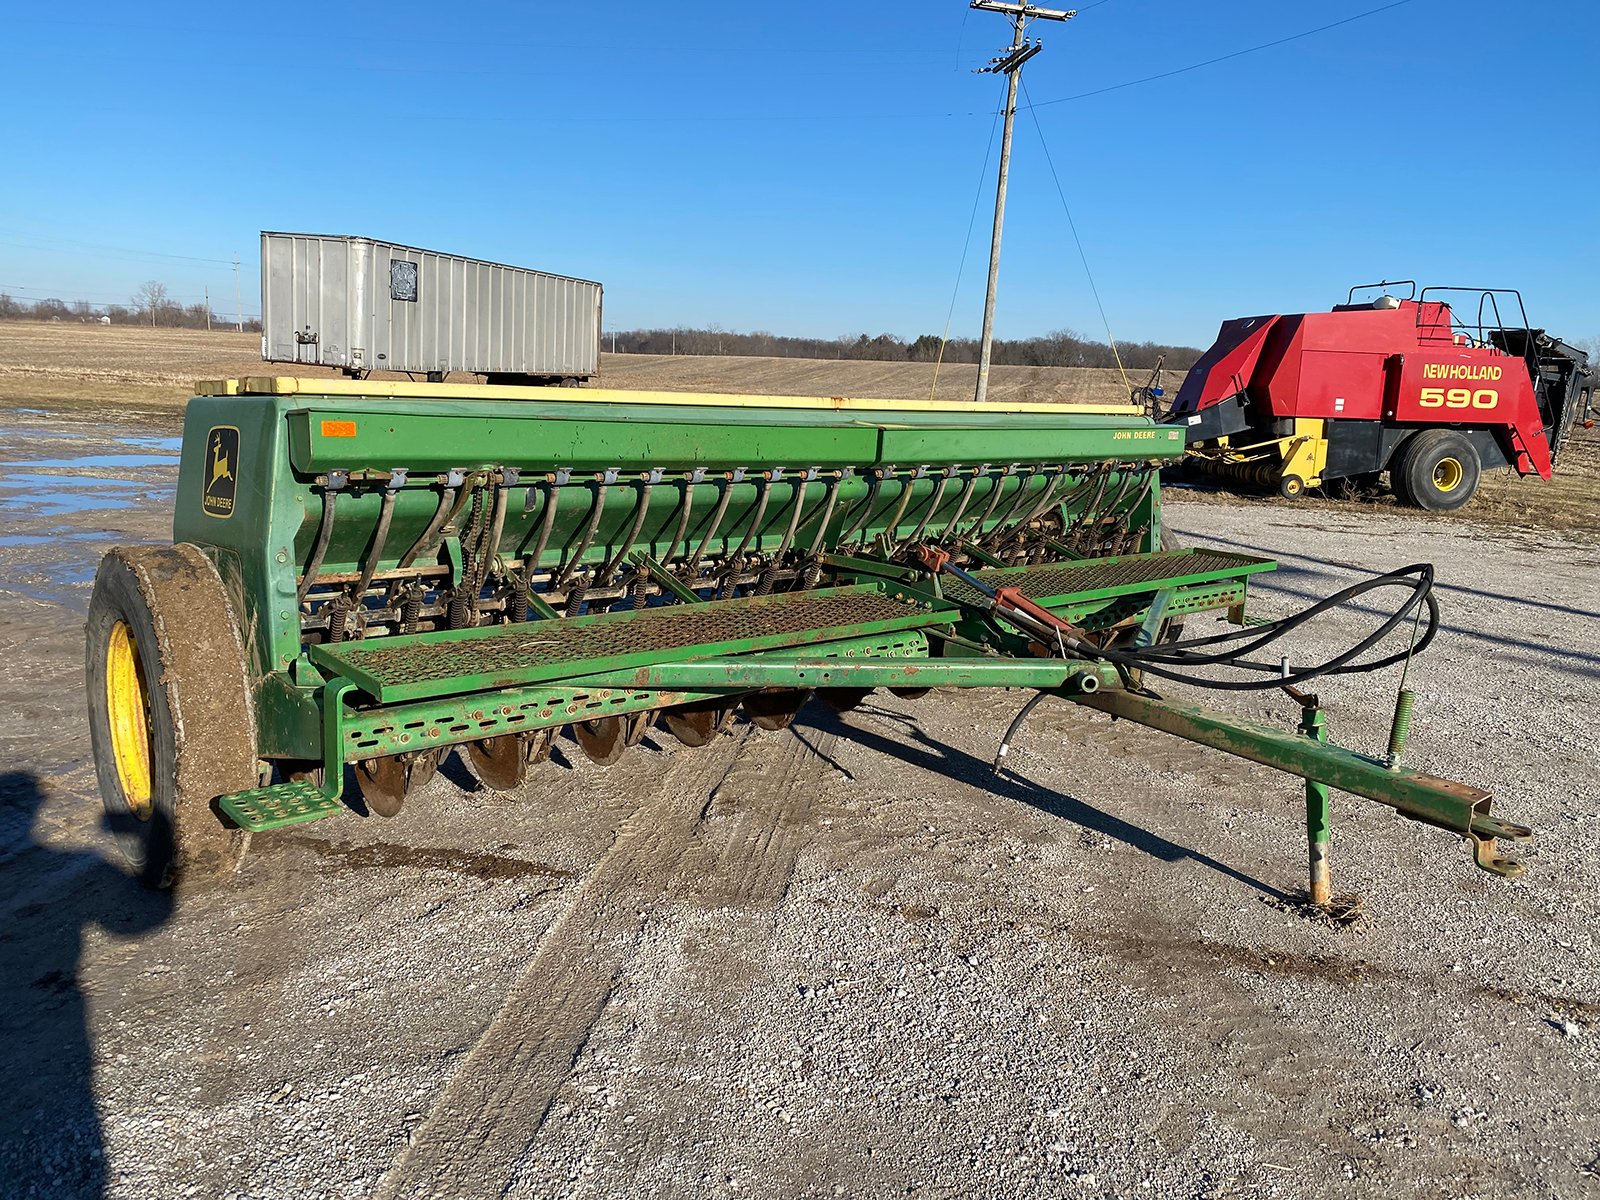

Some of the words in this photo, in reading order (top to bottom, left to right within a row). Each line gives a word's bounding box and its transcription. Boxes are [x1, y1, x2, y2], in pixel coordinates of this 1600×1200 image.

[1423, 363, 1449, 379] NEW
[1449, 364, 1503, 381] HOLLAND
[1419, 387, 1499, 409] 590
[1113, 431, 1131, 440] JOHN
[1134, 431, 1156, 439] DEERE
[204, 495, 217, 507] JOHN
[217, 497, 232, 509] DEERE
